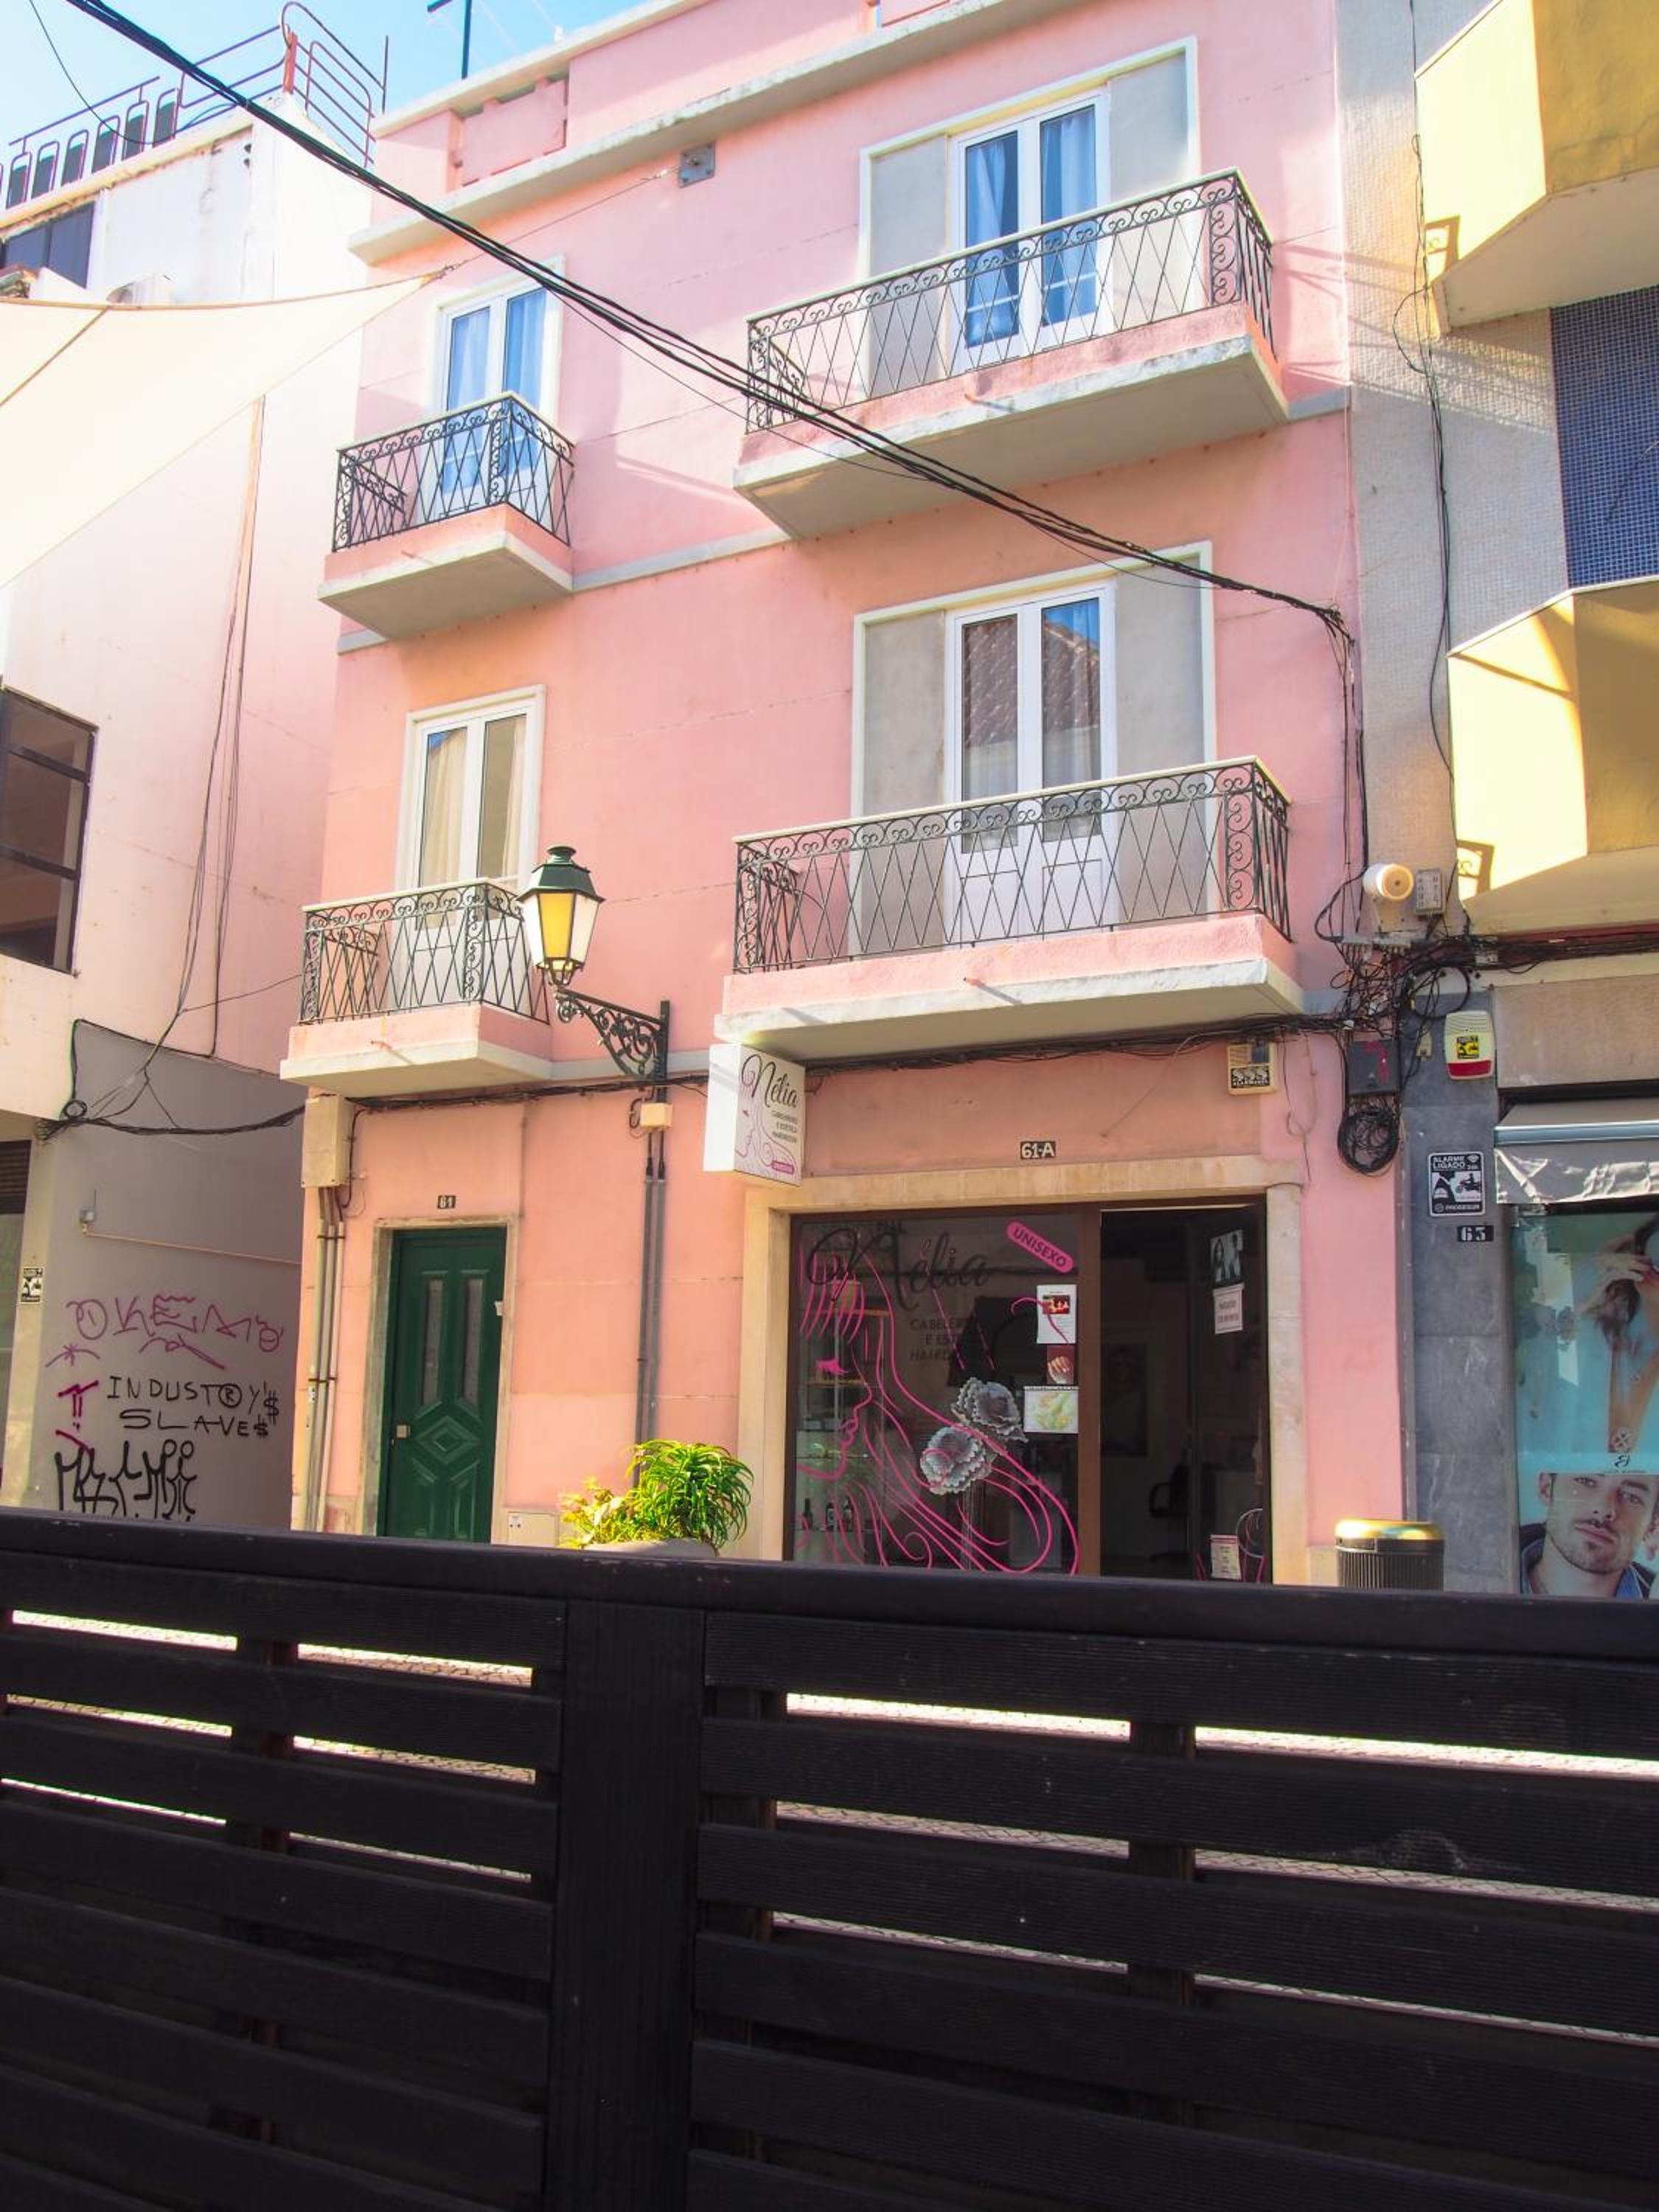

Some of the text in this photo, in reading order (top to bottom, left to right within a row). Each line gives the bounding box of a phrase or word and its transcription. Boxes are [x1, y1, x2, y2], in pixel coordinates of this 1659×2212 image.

[741, 1054, 798, 1108] Nélia
[1433, 1161, 1465, 1169] LIGADO
[1013, 1226, 1067, 1267] UNISEXO
